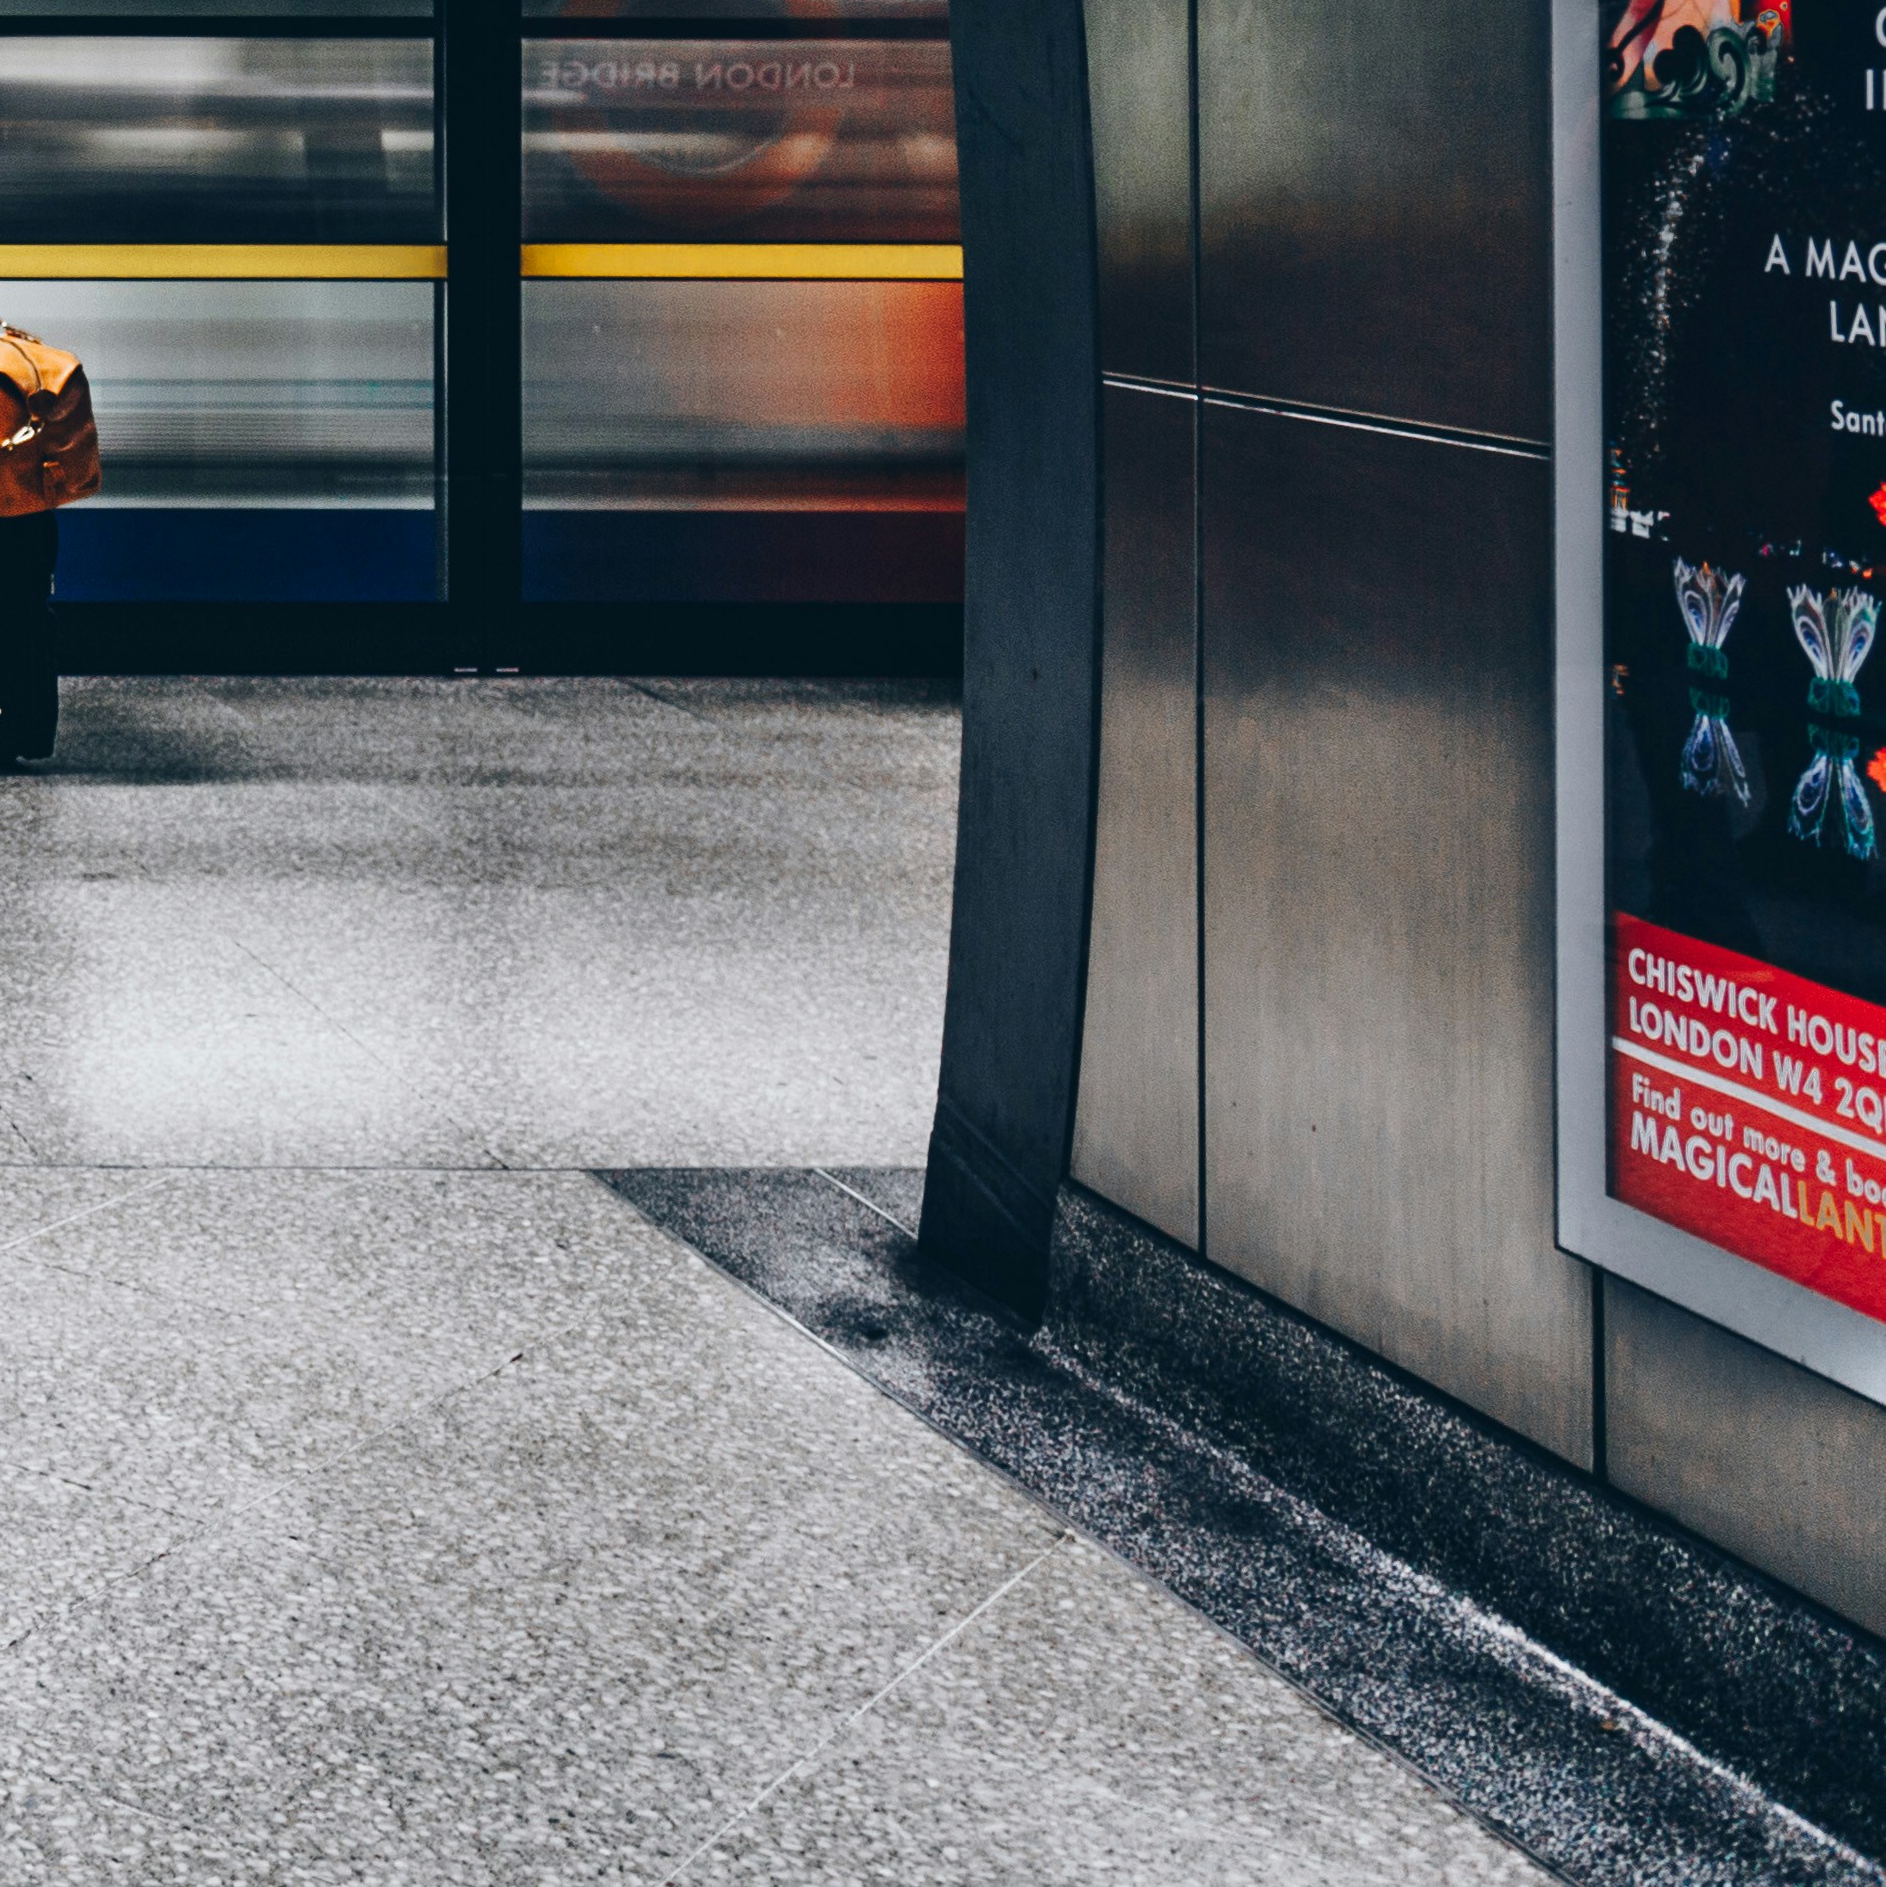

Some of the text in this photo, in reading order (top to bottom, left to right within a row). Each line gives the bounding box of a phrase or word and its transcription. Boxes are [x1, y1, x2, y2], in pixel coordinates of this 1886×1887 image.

[1866, 67, 1886, 112] I
[1763, 232, 1791, 276] A
[1830, 399, 1886, 438] Sant
[1628, 948, 1779, 1035] CHISWICK
[1629, 996, 1886, 1134] LONDON W4 2Q
[1631, 1072, 1886, 1208] Find out more & bo
